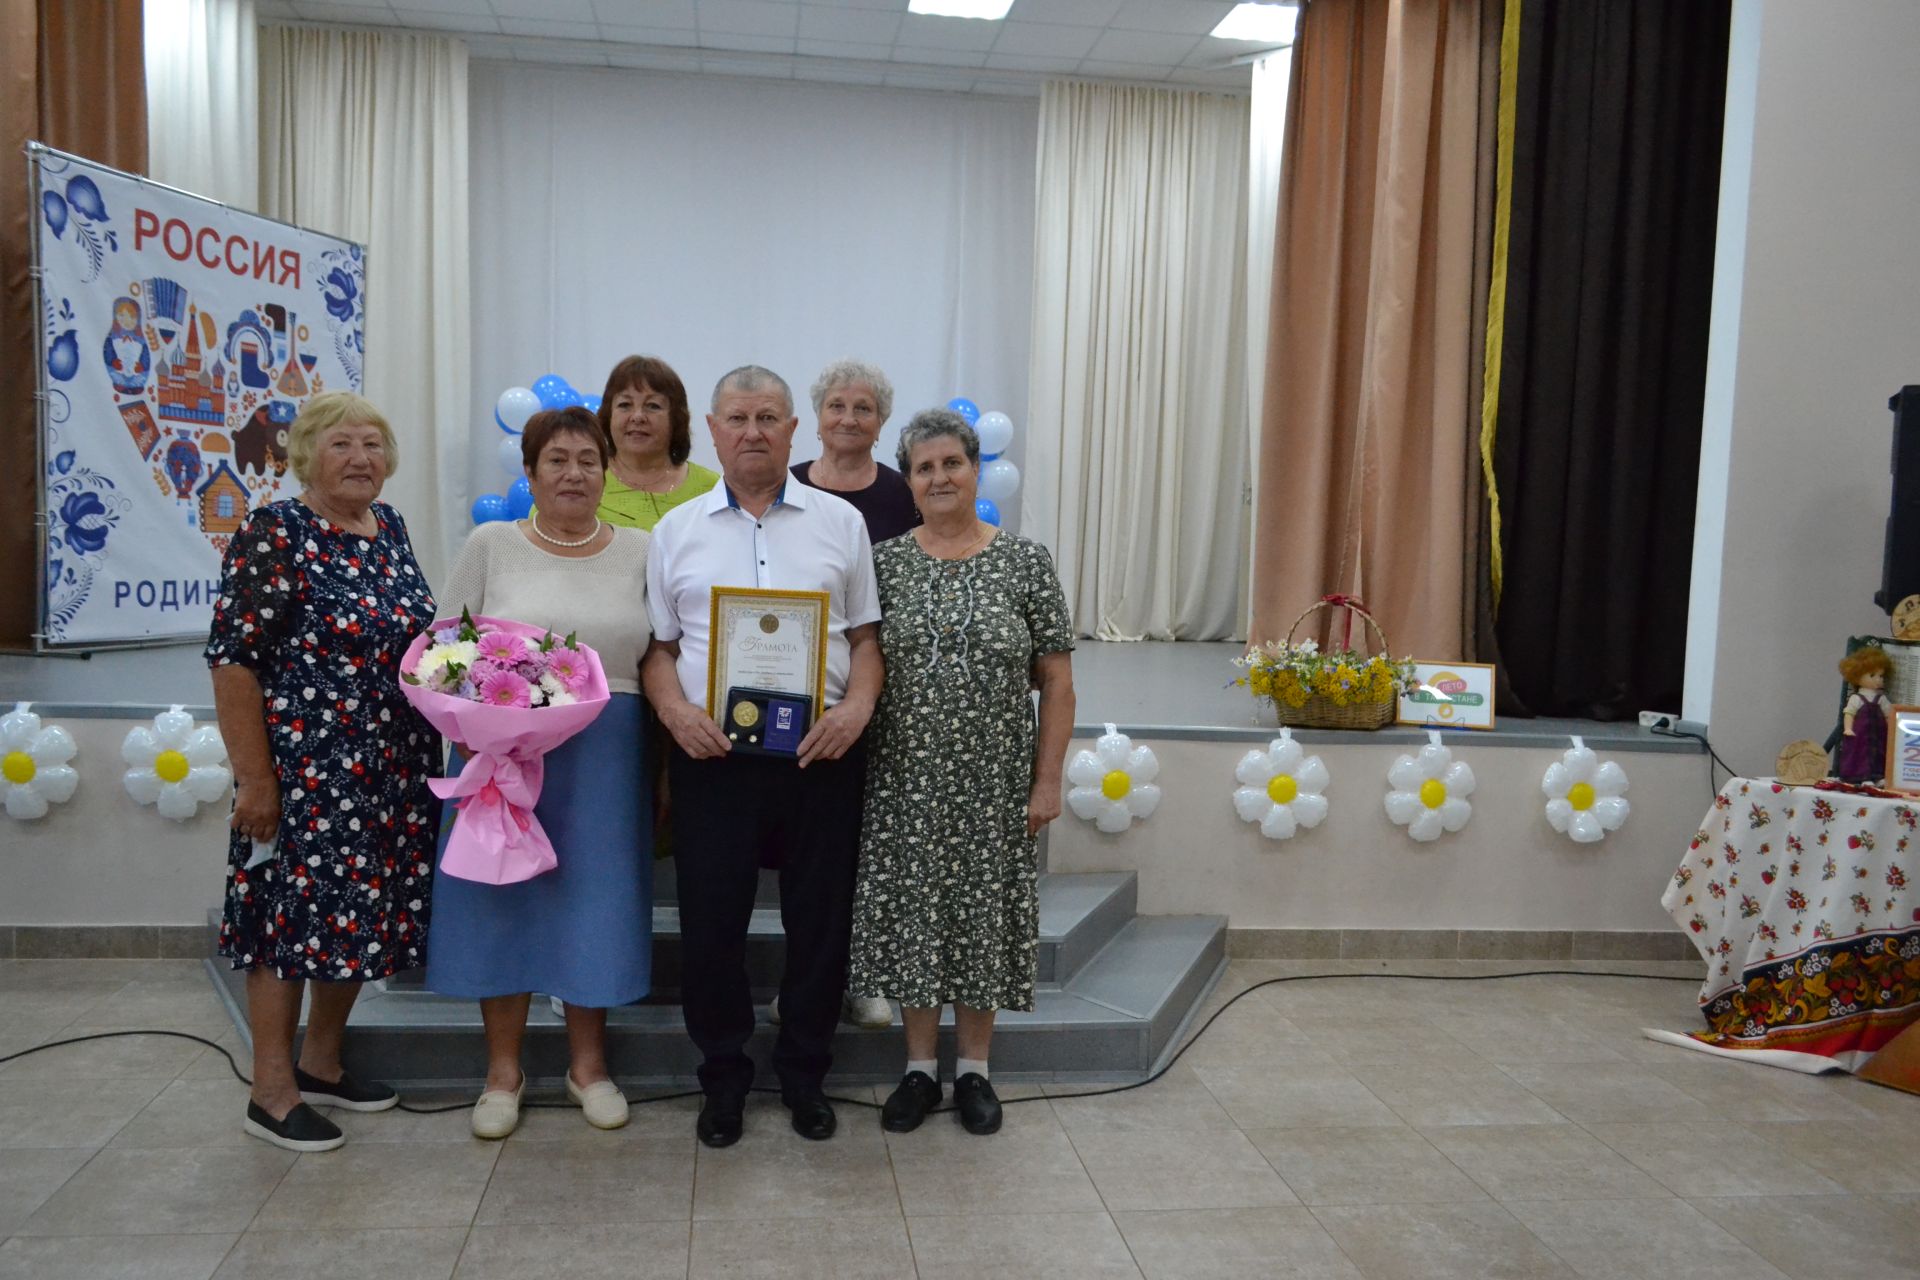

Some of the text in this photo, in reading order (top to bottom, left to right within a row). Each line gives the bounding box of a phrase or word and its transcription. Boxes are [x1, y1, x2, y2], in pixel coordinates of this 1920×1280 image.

[135, 208, 300, 289] РОССИЯ
[115, 580, 221, 611] РОДИН
[1442, 681, 1463, 691] ЛЕТО
[1426, 693, 1478, 704] ТАСТАНЕ
